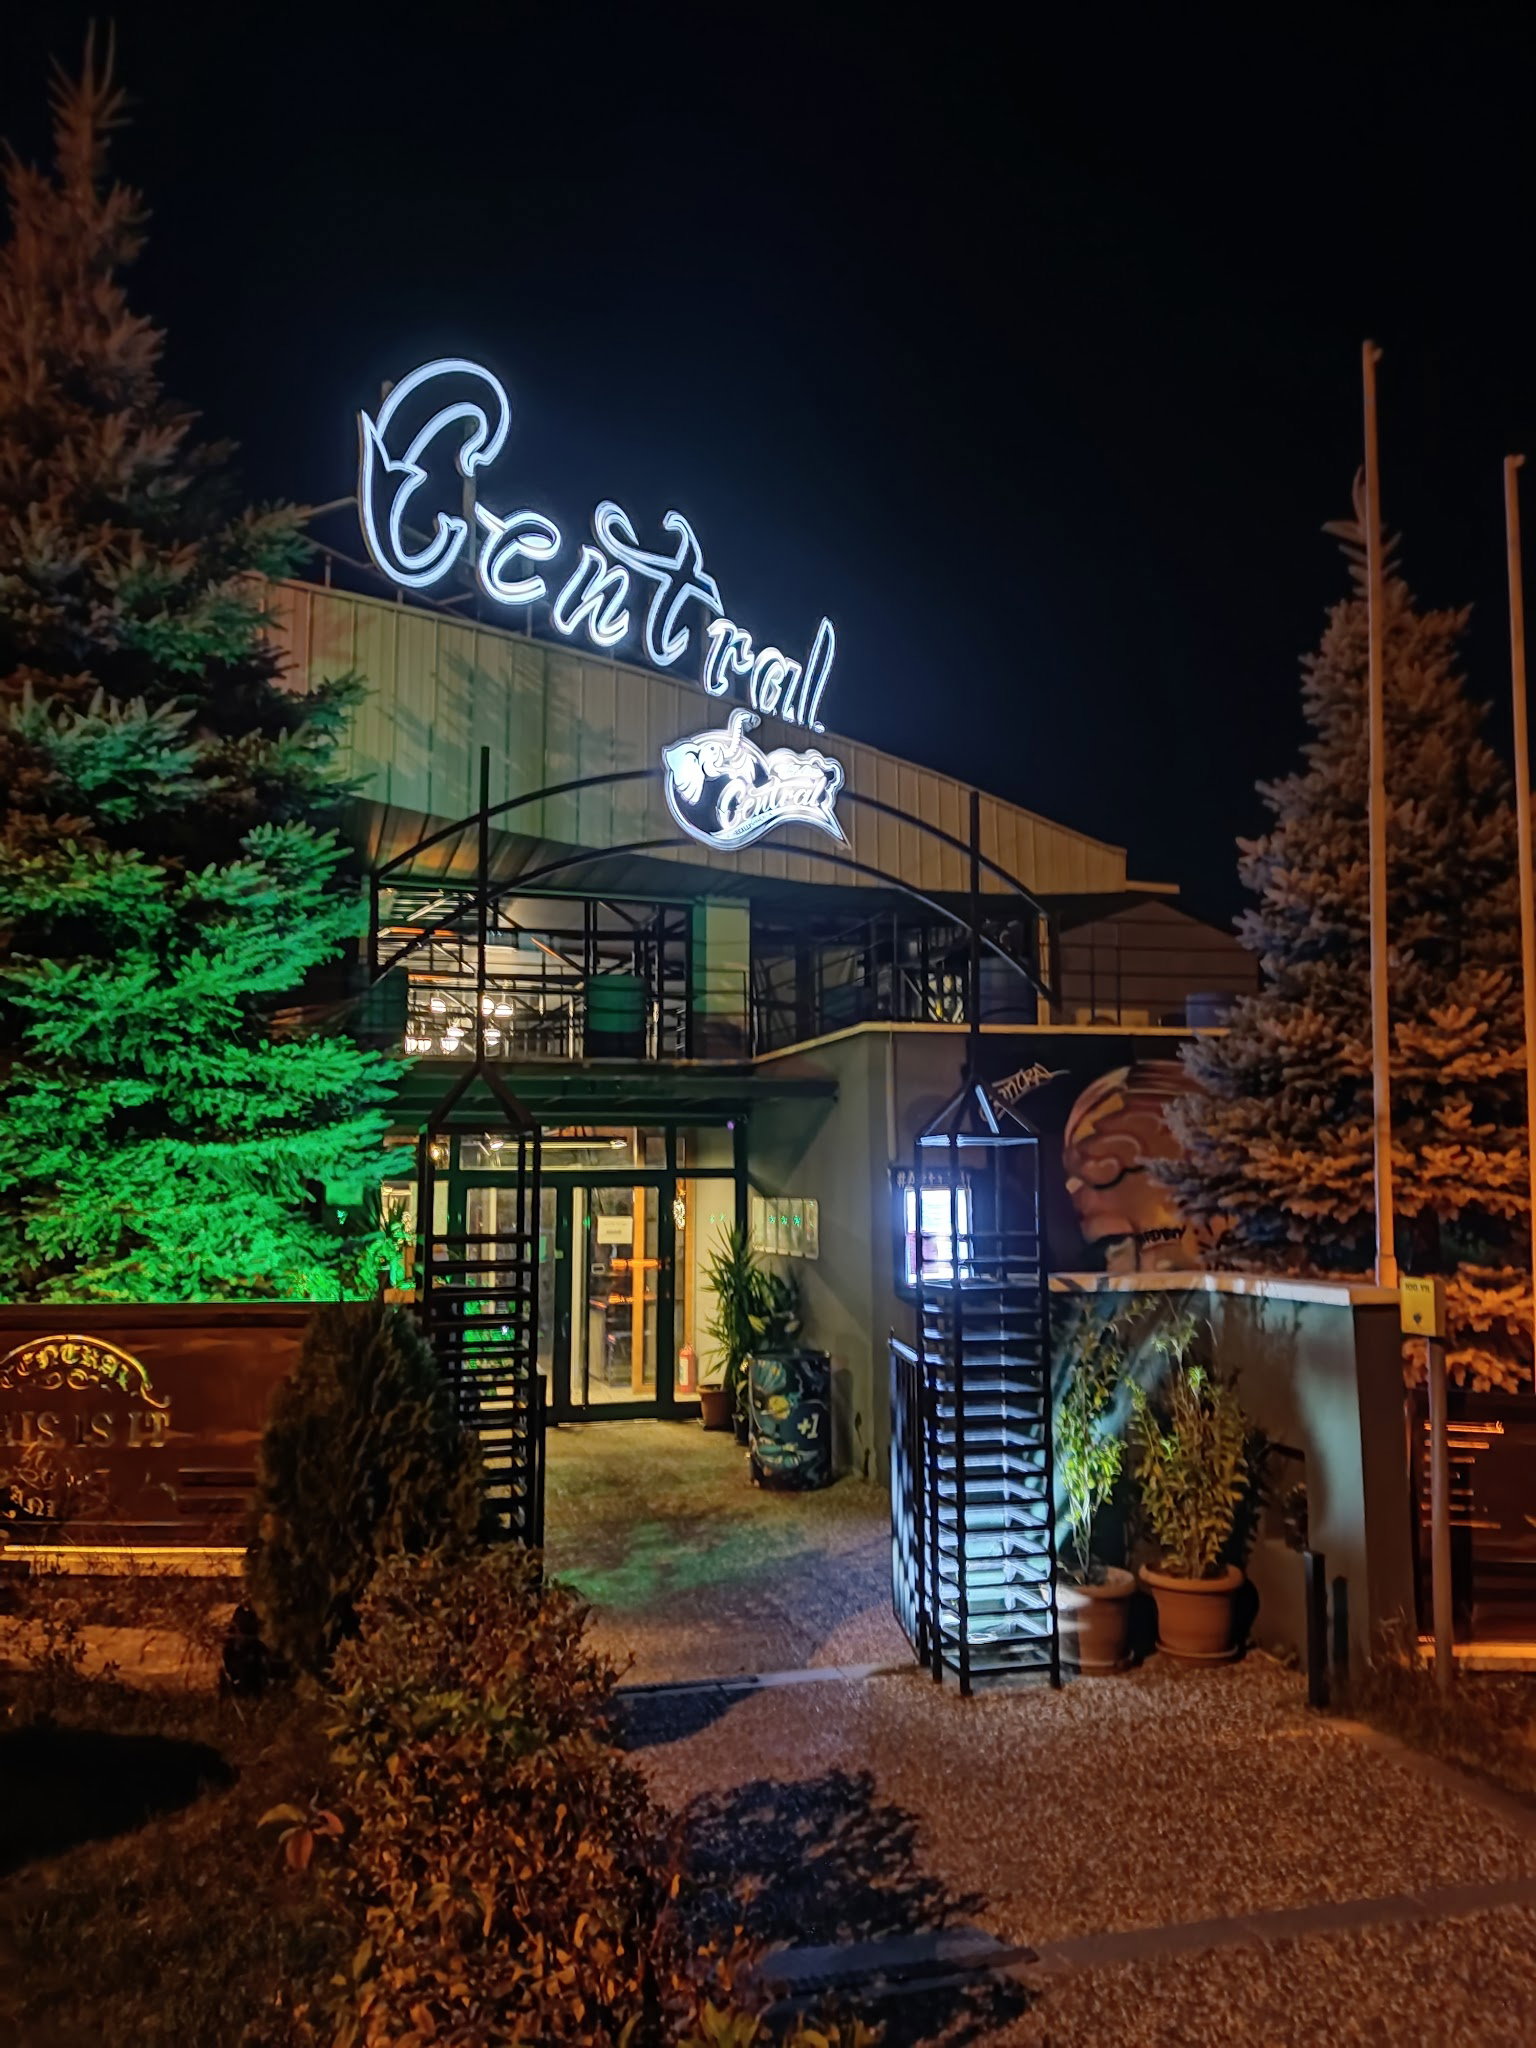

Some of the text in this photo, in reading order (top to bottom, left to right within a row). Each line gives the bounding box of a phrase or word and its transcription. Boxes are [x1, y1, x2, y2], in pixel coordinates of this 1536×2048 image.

[358, 358, 836, 732] Central
[717, 775, 828, 828] Central
[74, 1411, 115, 1448] IS
[128, 1411, 170, 1448] IT
